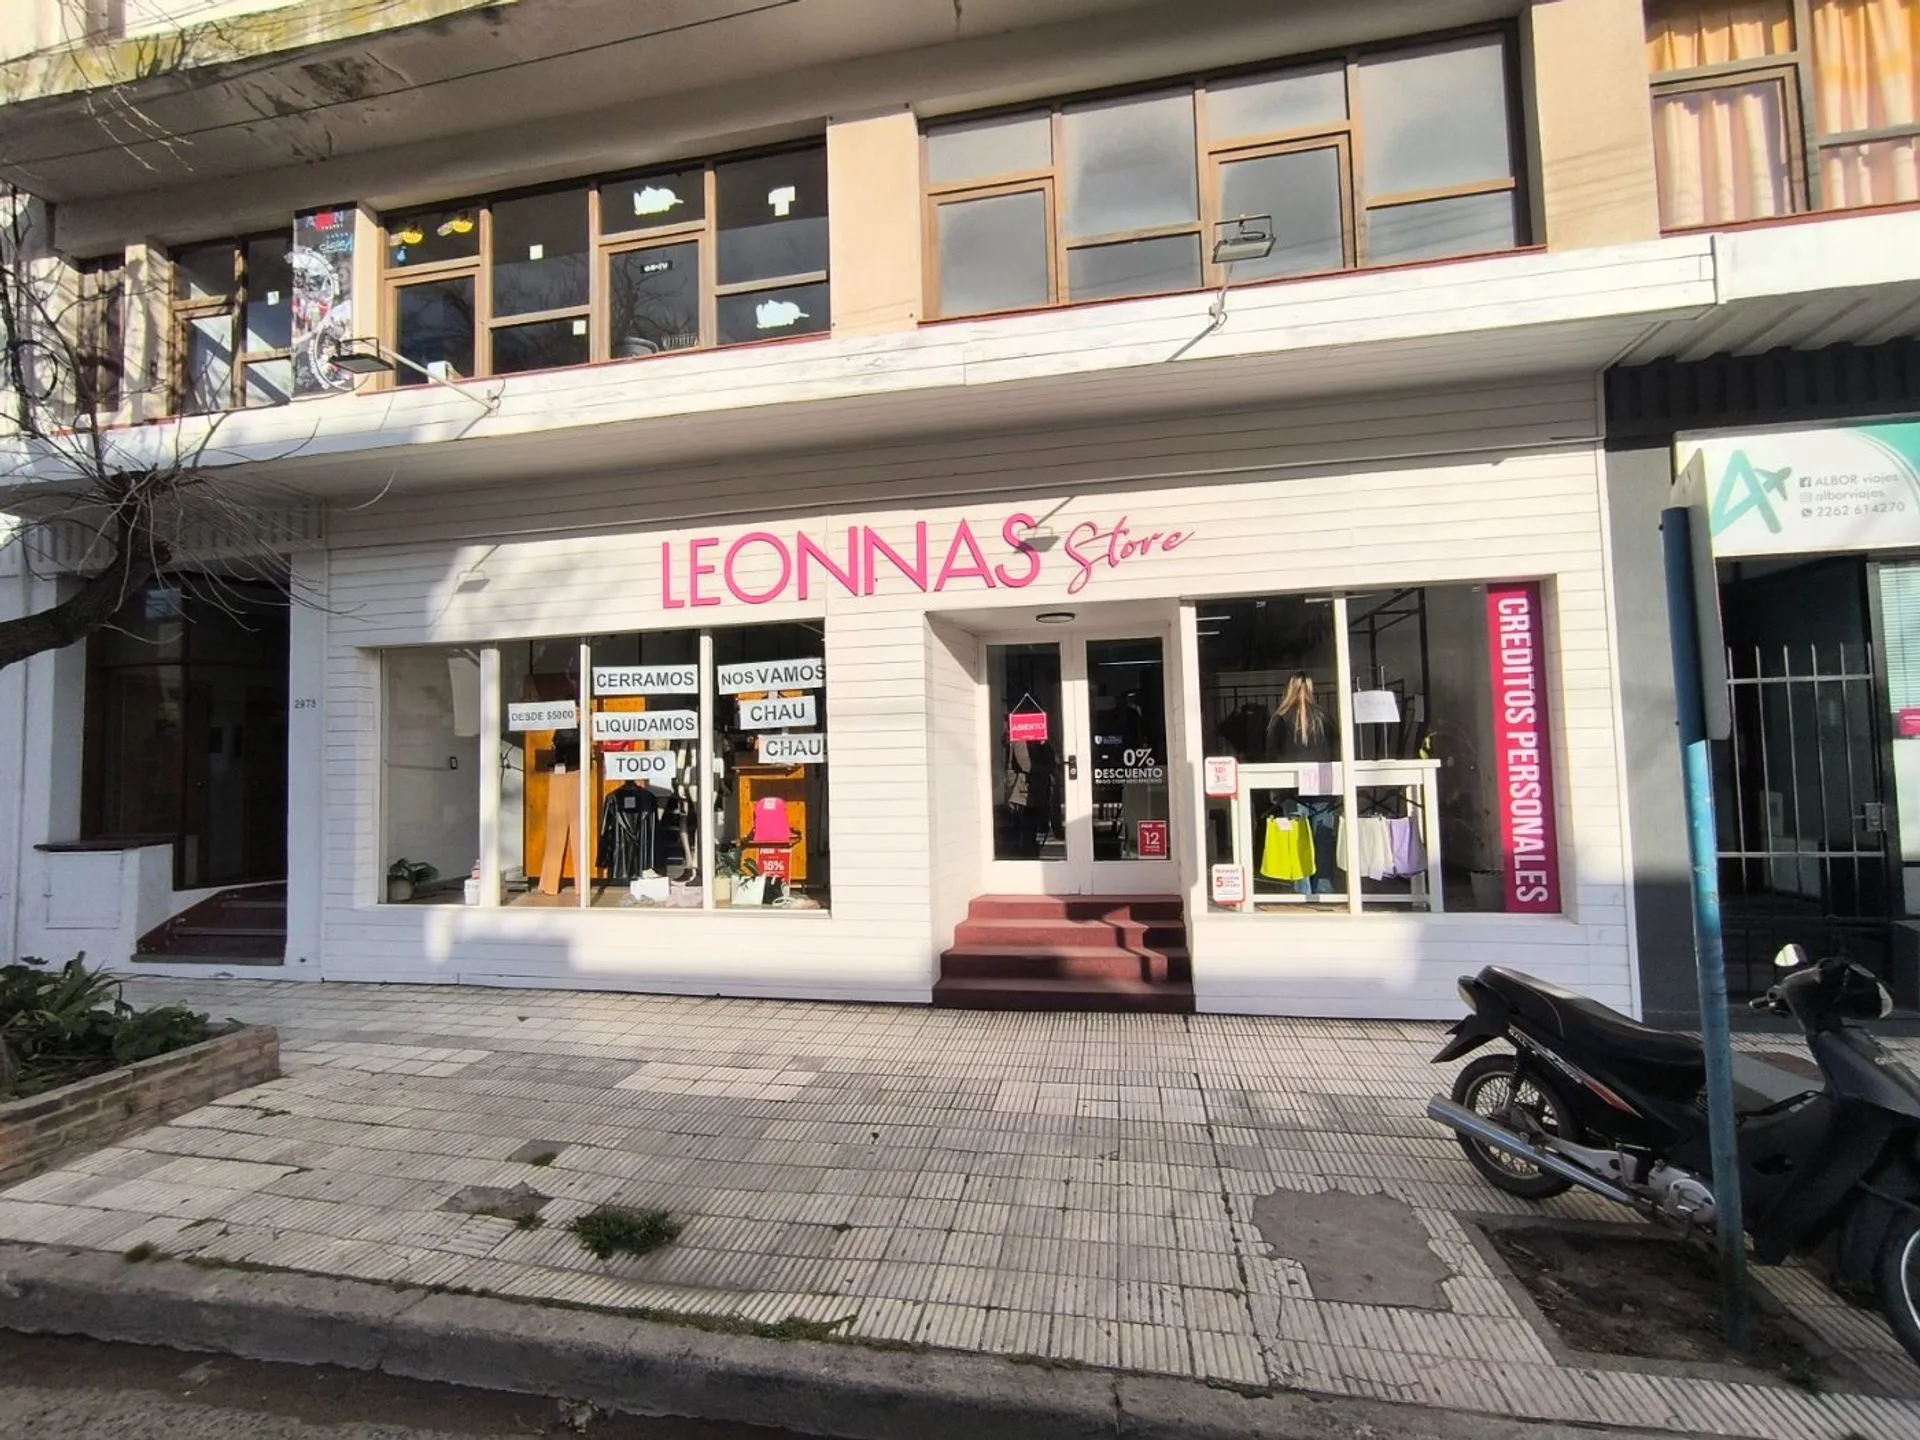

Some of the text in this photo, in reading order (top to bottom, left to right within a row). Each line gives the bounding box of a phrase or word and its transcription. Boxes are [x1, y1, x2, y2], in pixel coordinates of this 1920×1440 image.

[1815, 474, 1857, 486] ALBOR
[1815, 504, 1850, 518] 2262
[662, 513, 1196, 609] LEONNAS Store
[596, 671, 695, 688] CERRAMOS
[720, 664, 826, 686] NOS VAMOS
[511, 711, 545, 722] DESDE
[750, 702, 806, 723] CHAU
[596, 717, 696, 733] LIQUIDAMOS
[1498, 597, 1549, 903] CREDITOS PERSONALES
[615, 756, 667, 773] TODO
[1094, 767, 1163, 779] DESCUENTO
[1143, 831, 1160, 845] 12
[1215, 876, 1224, 888] 5
